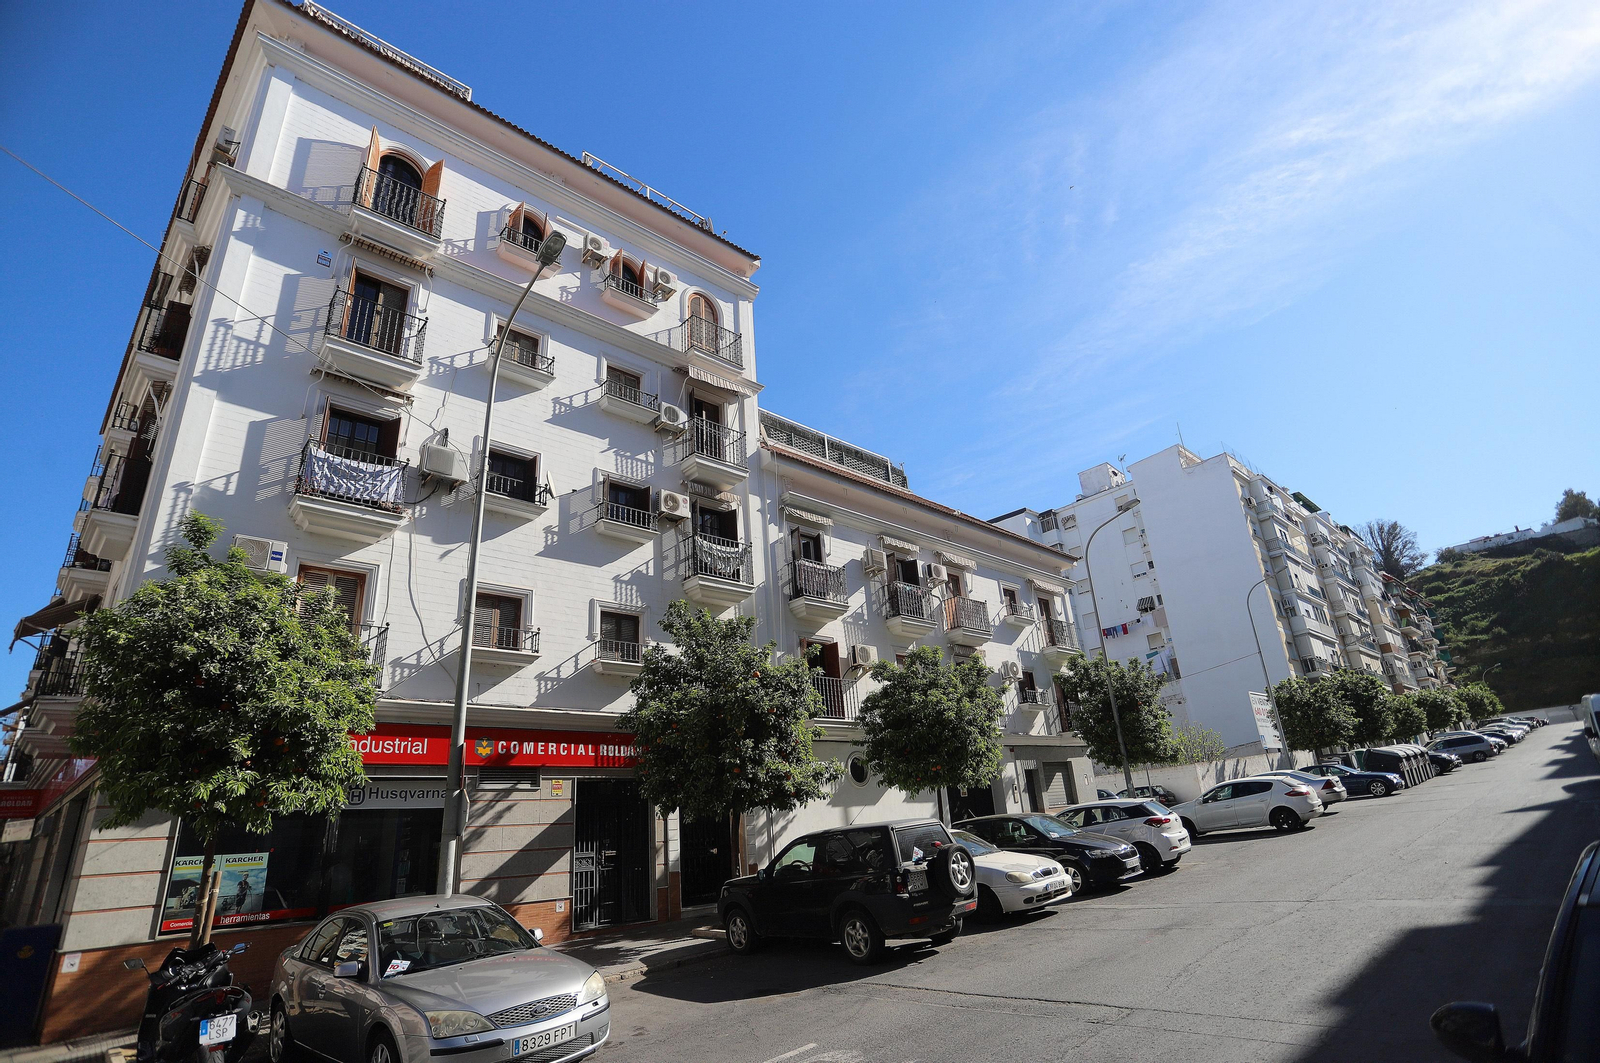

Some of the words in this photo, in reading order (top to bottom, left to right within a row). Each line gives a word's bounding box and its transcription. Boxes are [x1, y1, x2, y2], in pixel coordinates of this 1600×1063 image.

[345, 735, 428, 755] ndustrial
[497, 740, 596, 757] COMERCIAL
[368, 786, 447, 803] Husqvarna
[220, 912, 271, 925] herramientas
[209, 1016, 235, 1031] 6477
[208, 1027, 228, 1041] LSP
[521, 1032, 551, 1052] 8329
[553, 1024, 574, 1043] FPT
